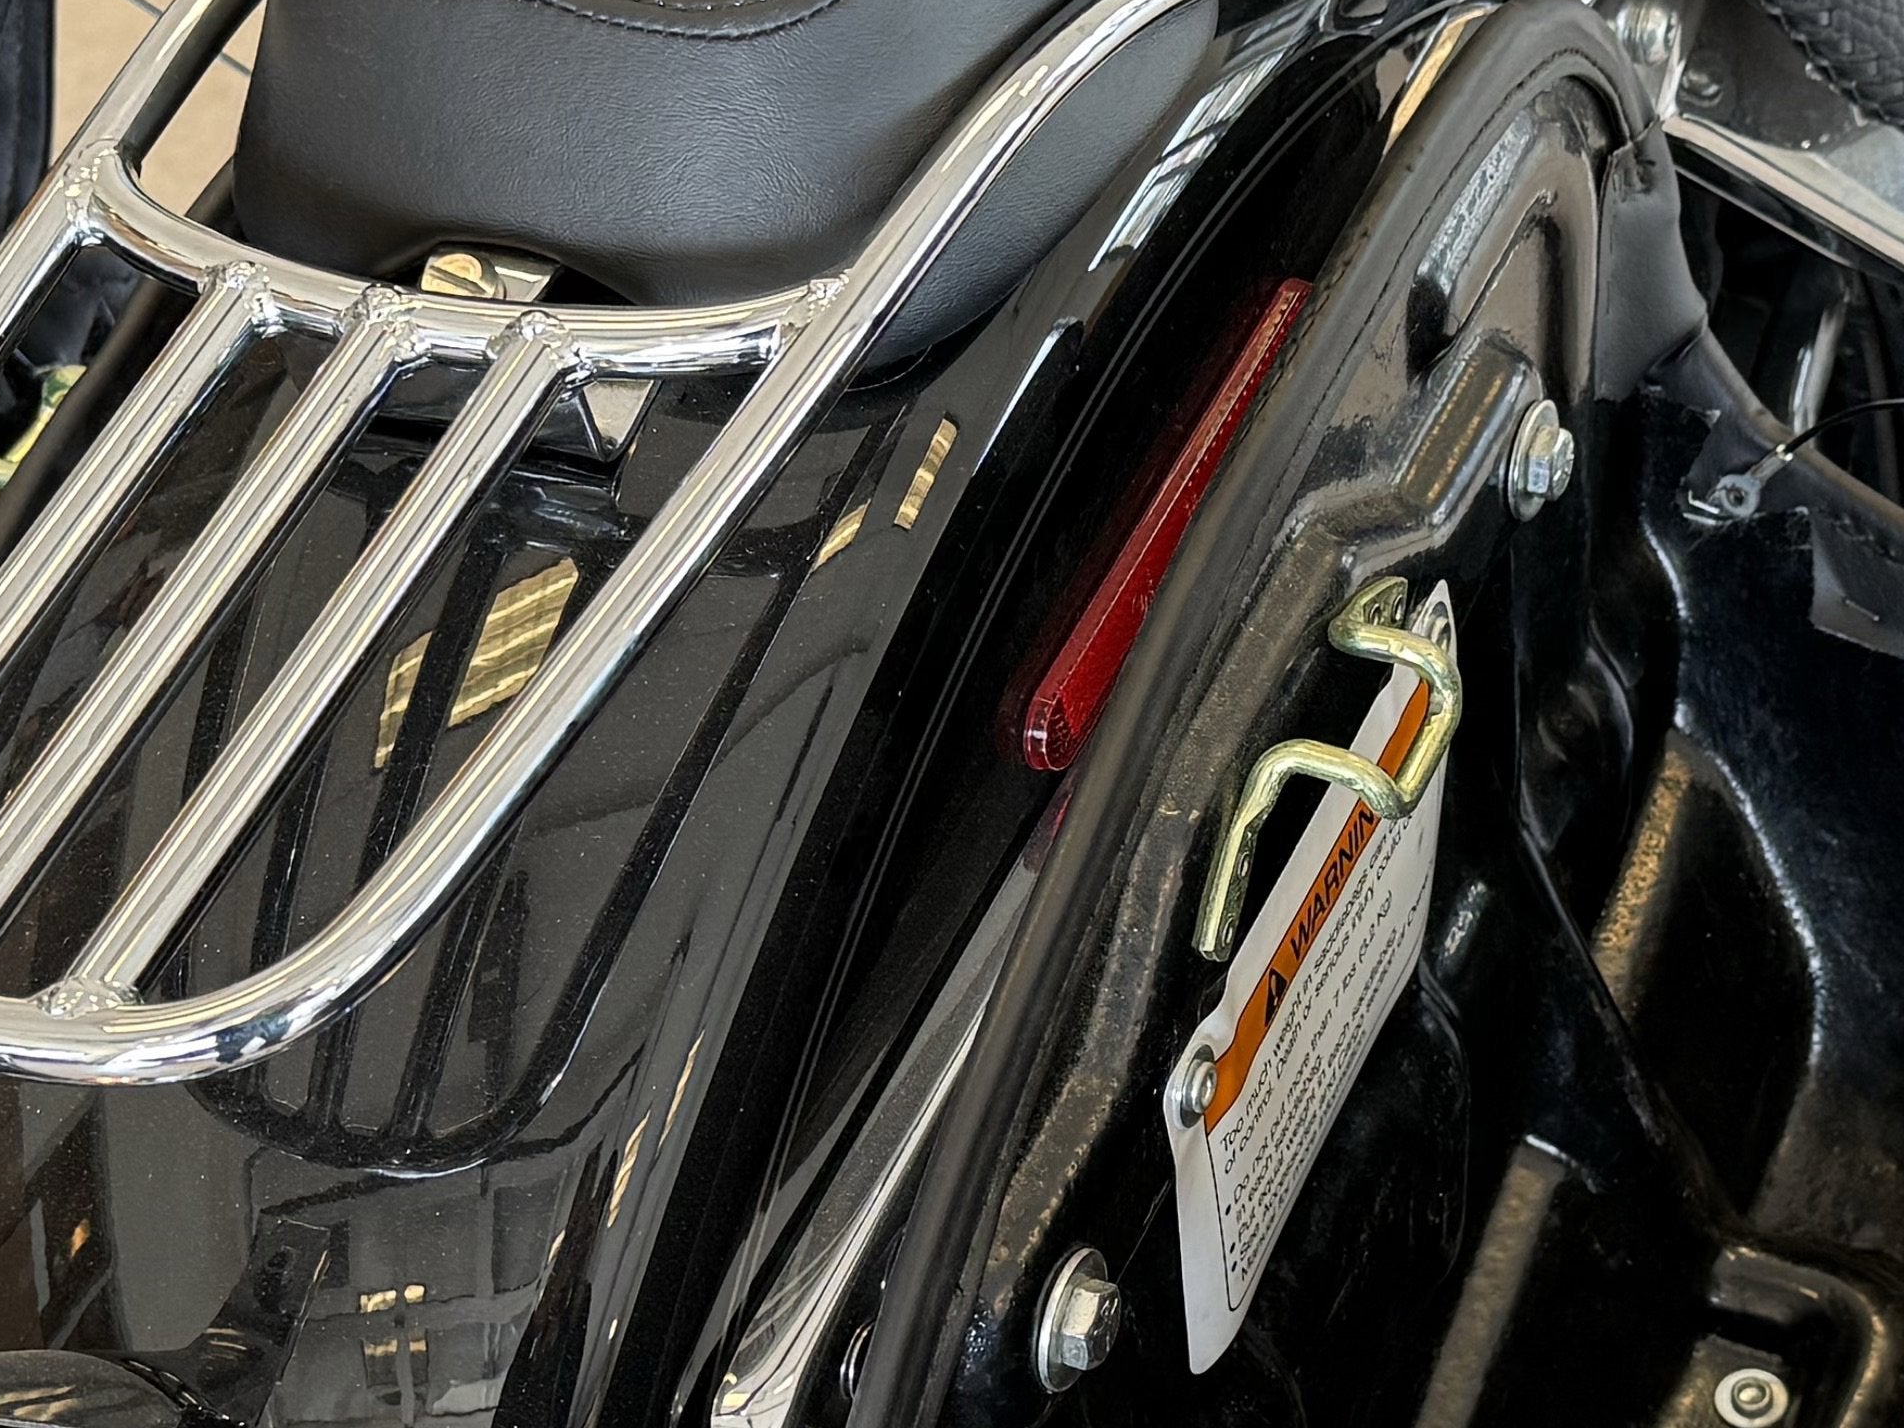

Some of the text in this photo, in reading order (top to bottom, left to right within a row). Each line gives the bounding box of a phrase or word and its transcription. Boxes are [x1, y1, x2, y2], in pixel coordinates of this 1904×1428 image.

[1219, 832, 1388, 1153] Too much weight in saddlebags can
[1289, 808, 1375, 962] WARNIN
[1224, 1147, 1237, 1175] of
[1275, 1020, 1302, 1081] Death
[1302, 994, 1313, 1021] or
[1314, 930, 1351, 999] serious
[1350, 879, 1375, 933] injury
[1375, 825, 1402, 882] could
[1233, 1173, 1251, 1205] Do
[1252, 1135, 1270, 1174] not
[1269, 1100, 1286, 1143] put
[1286, 1051, 1311, 1105] more
[1310, 1008, 1333, 1053] than
[1332, 987, 1341, 1008] 7
[1341, 961, 1357, 994] lbs
[1235, 1202, 1247, 1225] in
[1247, 1152, 1273, 1203] each
[1237, 1205, 1257, 1245] Put
[1257, 1148, 1285, 1208] equal
[1285, 1086, 1317, 1152] weight
[1316, 1068, 1327, 1090] in
[1327, 1021, 1350, 1069] each
[1239, 1221, 1260, 1263] See
